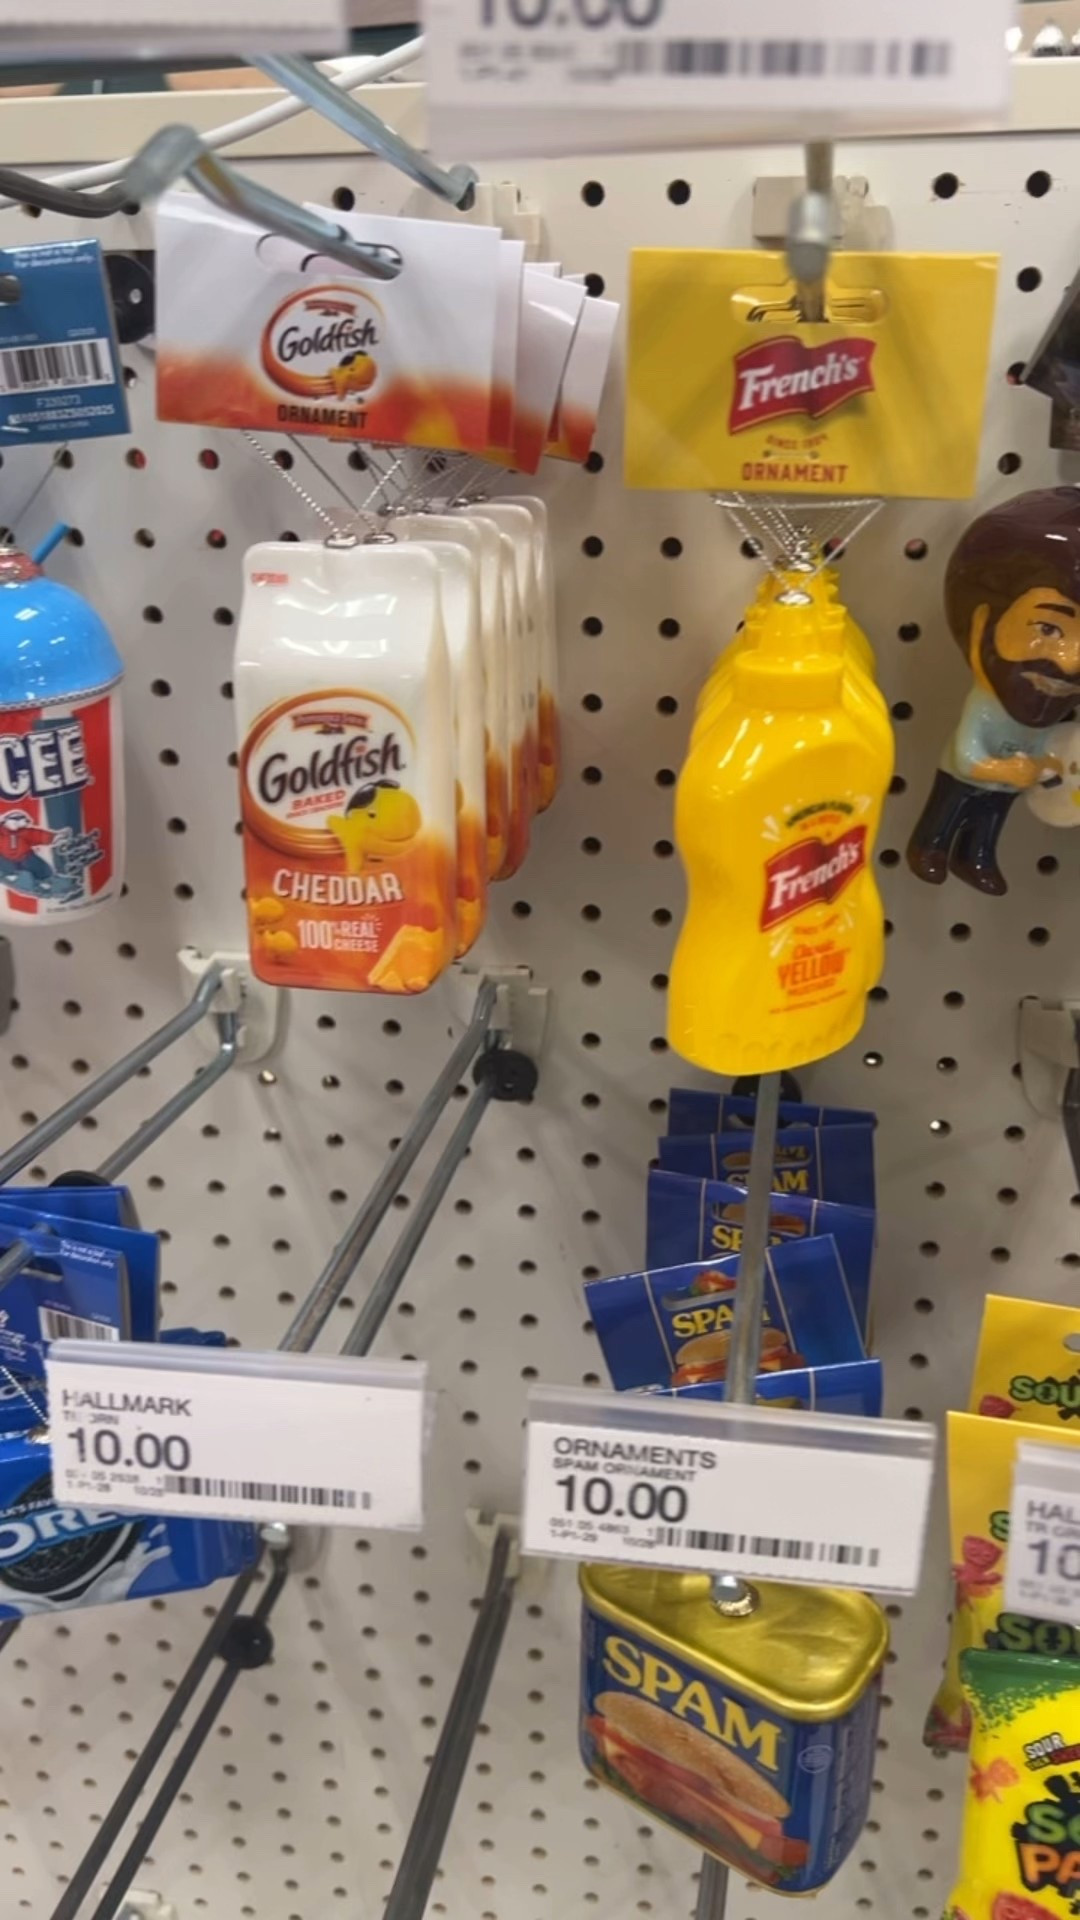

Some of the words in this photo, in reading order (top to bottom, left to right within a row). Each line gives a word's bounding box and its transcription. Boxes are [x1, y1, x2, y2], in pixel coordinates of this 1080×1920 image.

[278, 318, 379, 362] Goldfish
[738, 352, 859, 411] French's
[277, 404, 368, 428] ORNAMENT
[742, 462, 848, 484] ORNAMENT
[259, 732, 401, 804] Goldfish
[292, 789, 346, 811] BAKED
[273, 868, 404, 907] CHEDDAR
[768, 842, 860, 910] French's
[340, 920, 379, 938] REAL
[62, 1388, 193, 1417] HALLMARK
[67, 1426, 191, 1472] 10.00
[553, 1436, 717, 1470] ORNAMENTS
[552, 1456, 599, 1473] SPAM
[602, 1462, 697, 1482] ORNAMENT
[555, 1473, 689, 1524] 10.00
[603, 1636, 781, 1771] SPAM
[1025, 1734, 1065, 1759] SOUR
